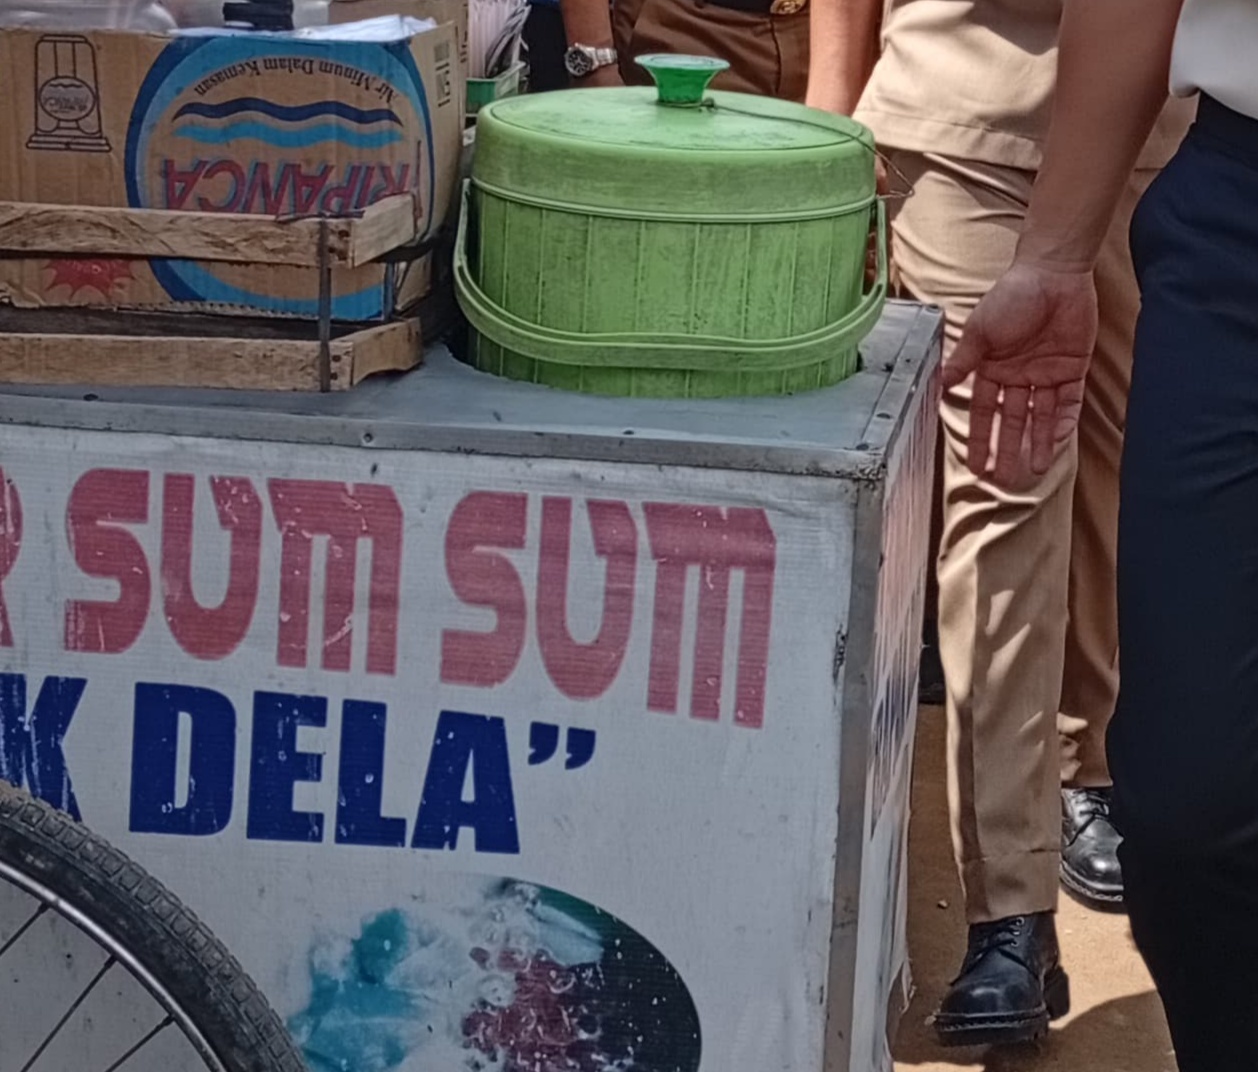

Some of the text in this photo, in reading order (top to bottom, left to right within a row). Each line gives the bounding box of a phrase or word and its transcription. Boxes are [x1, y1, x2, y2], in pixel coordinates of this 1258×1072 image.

[194, 57, 259, 96] Kemasan
[264, 57, 314, 75] Dalam
[319, 61, 380, 92] Minum
[64, 466, 405, 677] SUM
[438, 490, 778, 729] SUM
